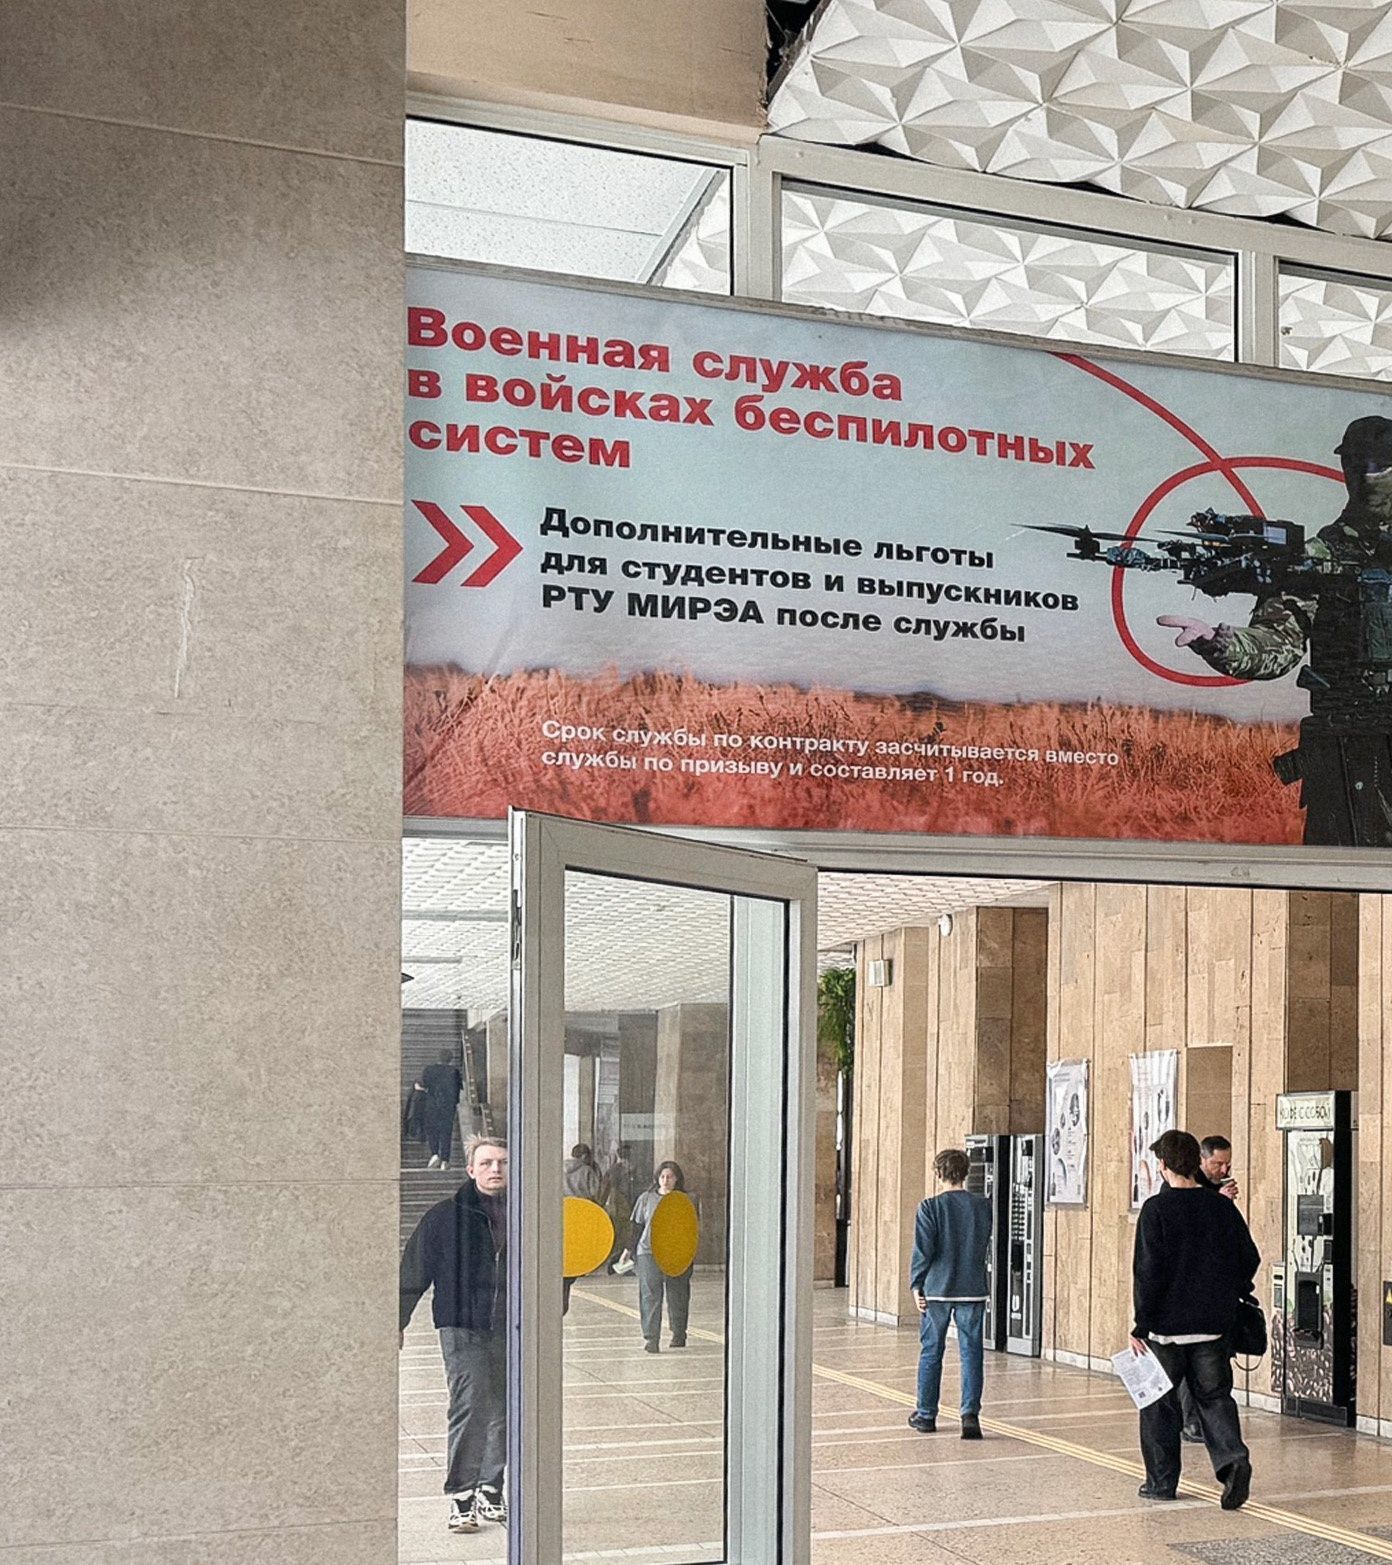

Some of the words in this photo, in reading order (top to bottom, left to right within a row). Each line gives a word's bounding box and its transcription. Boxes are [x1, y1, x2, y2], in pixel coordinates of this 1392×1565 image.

[406, 307, 669, 373] Военная
[693, 347, 902, 401] служба
[407, 366, 442, 398] в
[464, 372, 715, 426] войсках
[735, 393, 1096, 470] беспилотных
[408, 419, 631, 469] систем
[540, 506, 863, 558] Дополнительные
[873, 537, 994, 571] льготы
[541, 550, 608, 577] для
[621, 555, 812, 593] студентов
[823, 572, 844, 593] и
[857, 573, 1079, 612] выпускников
[542, 584, 614, 612] РТУ
[627, 592, 764, 625] МИРЭА
[776, 605, 881, 634] после
[893, 611, 1026, 644] службы
[541, 718, 607, 744] Срок
[612, 723, 707, 749] службы
[713, 733, 744, 750] по
[750, 735, 869, 757] контракту
[874, 741, 1040, 766] засчитывается
[1046, 749, 1119, 767] вместо
[541, 748, 637, 773] службы
[643, 756, 673, 773] по
[681, 759, 784, 779] призыву
[789, 764, 804, 778] и
[810, 766, 938, 785] составляет
[943, 767, 955, 783] 1
[962, 769, 1004, 788] год.
